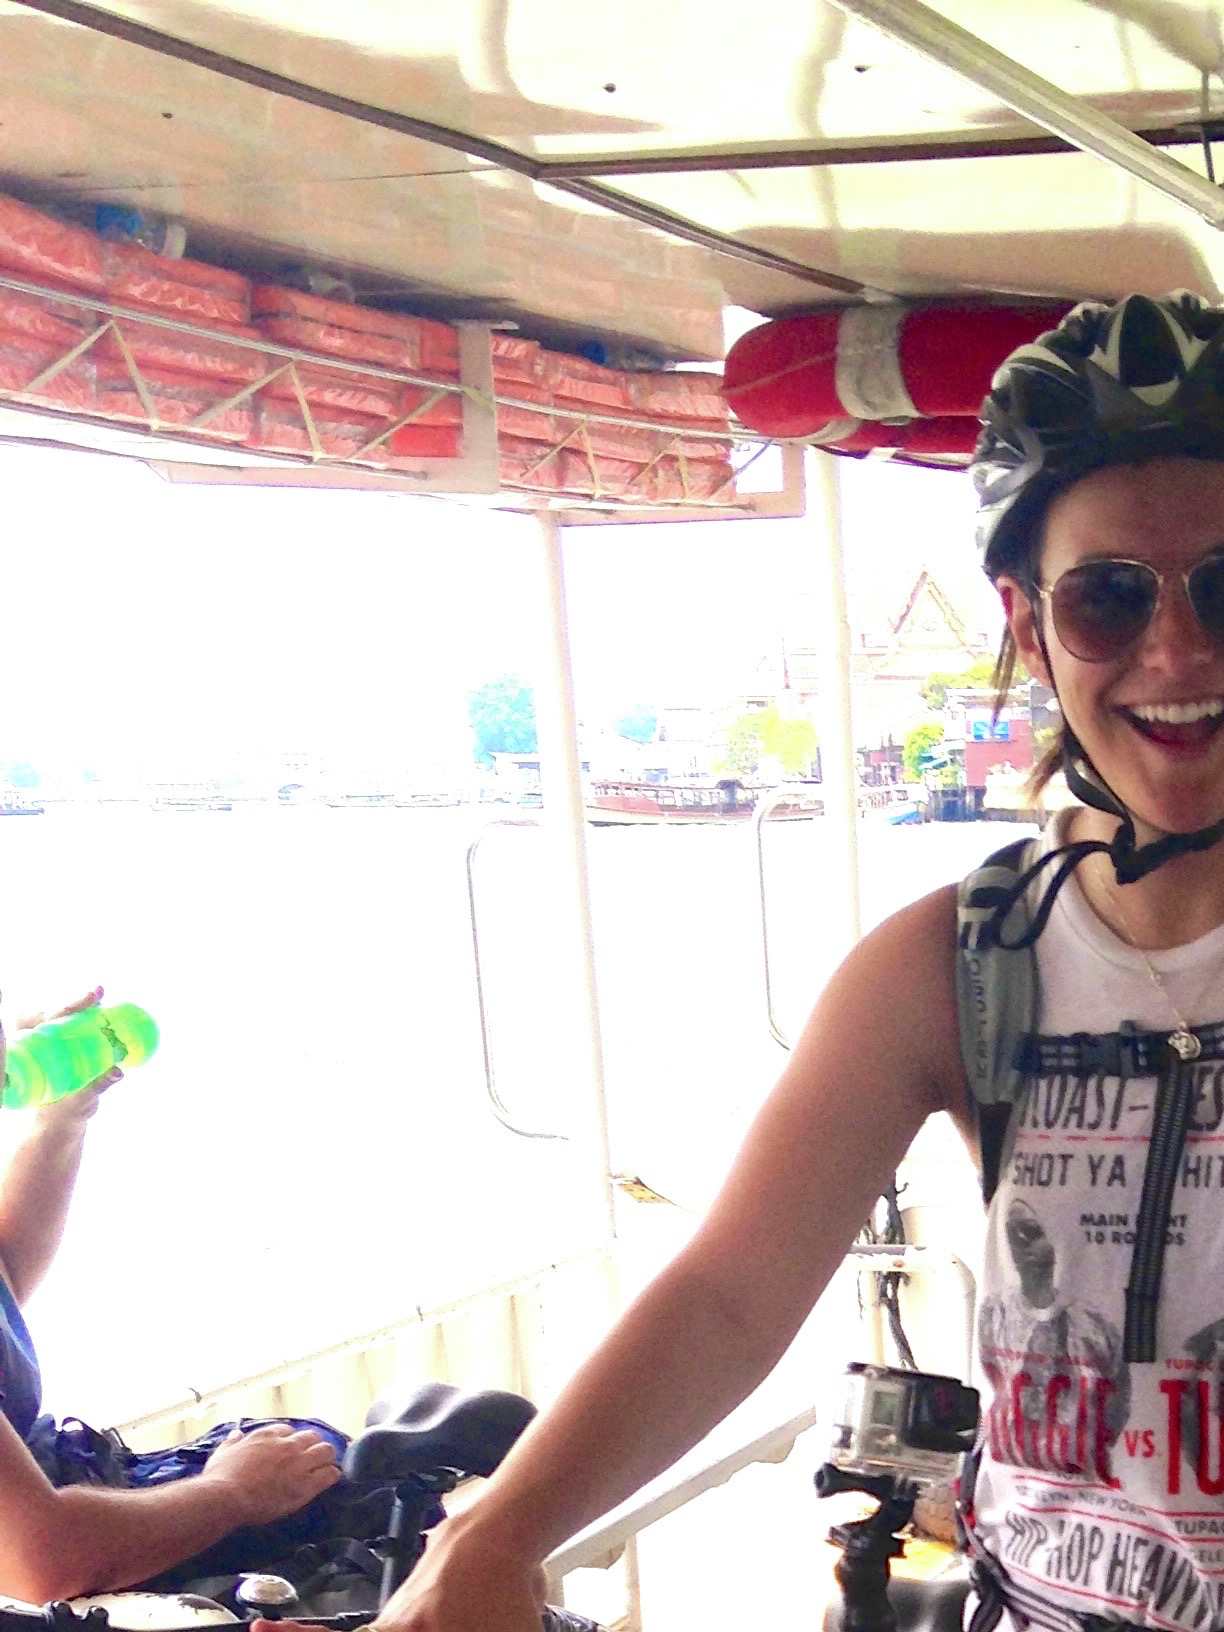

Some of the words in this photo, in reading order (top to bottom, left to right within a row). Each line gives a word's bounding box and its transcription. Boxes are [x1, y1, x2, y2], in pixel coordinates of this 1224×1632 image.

[1013, 1152, 1073, 1188] SHOT
[1087, 1152, 1127, 1188] YA
[1079, 1213, 1129, 1227] MAIN
[1085, 1231, 1106, 1246] 10
[1111, 1231, 1186, 1246] RODS
[1005, 1510, 1048, 1566] HIP
